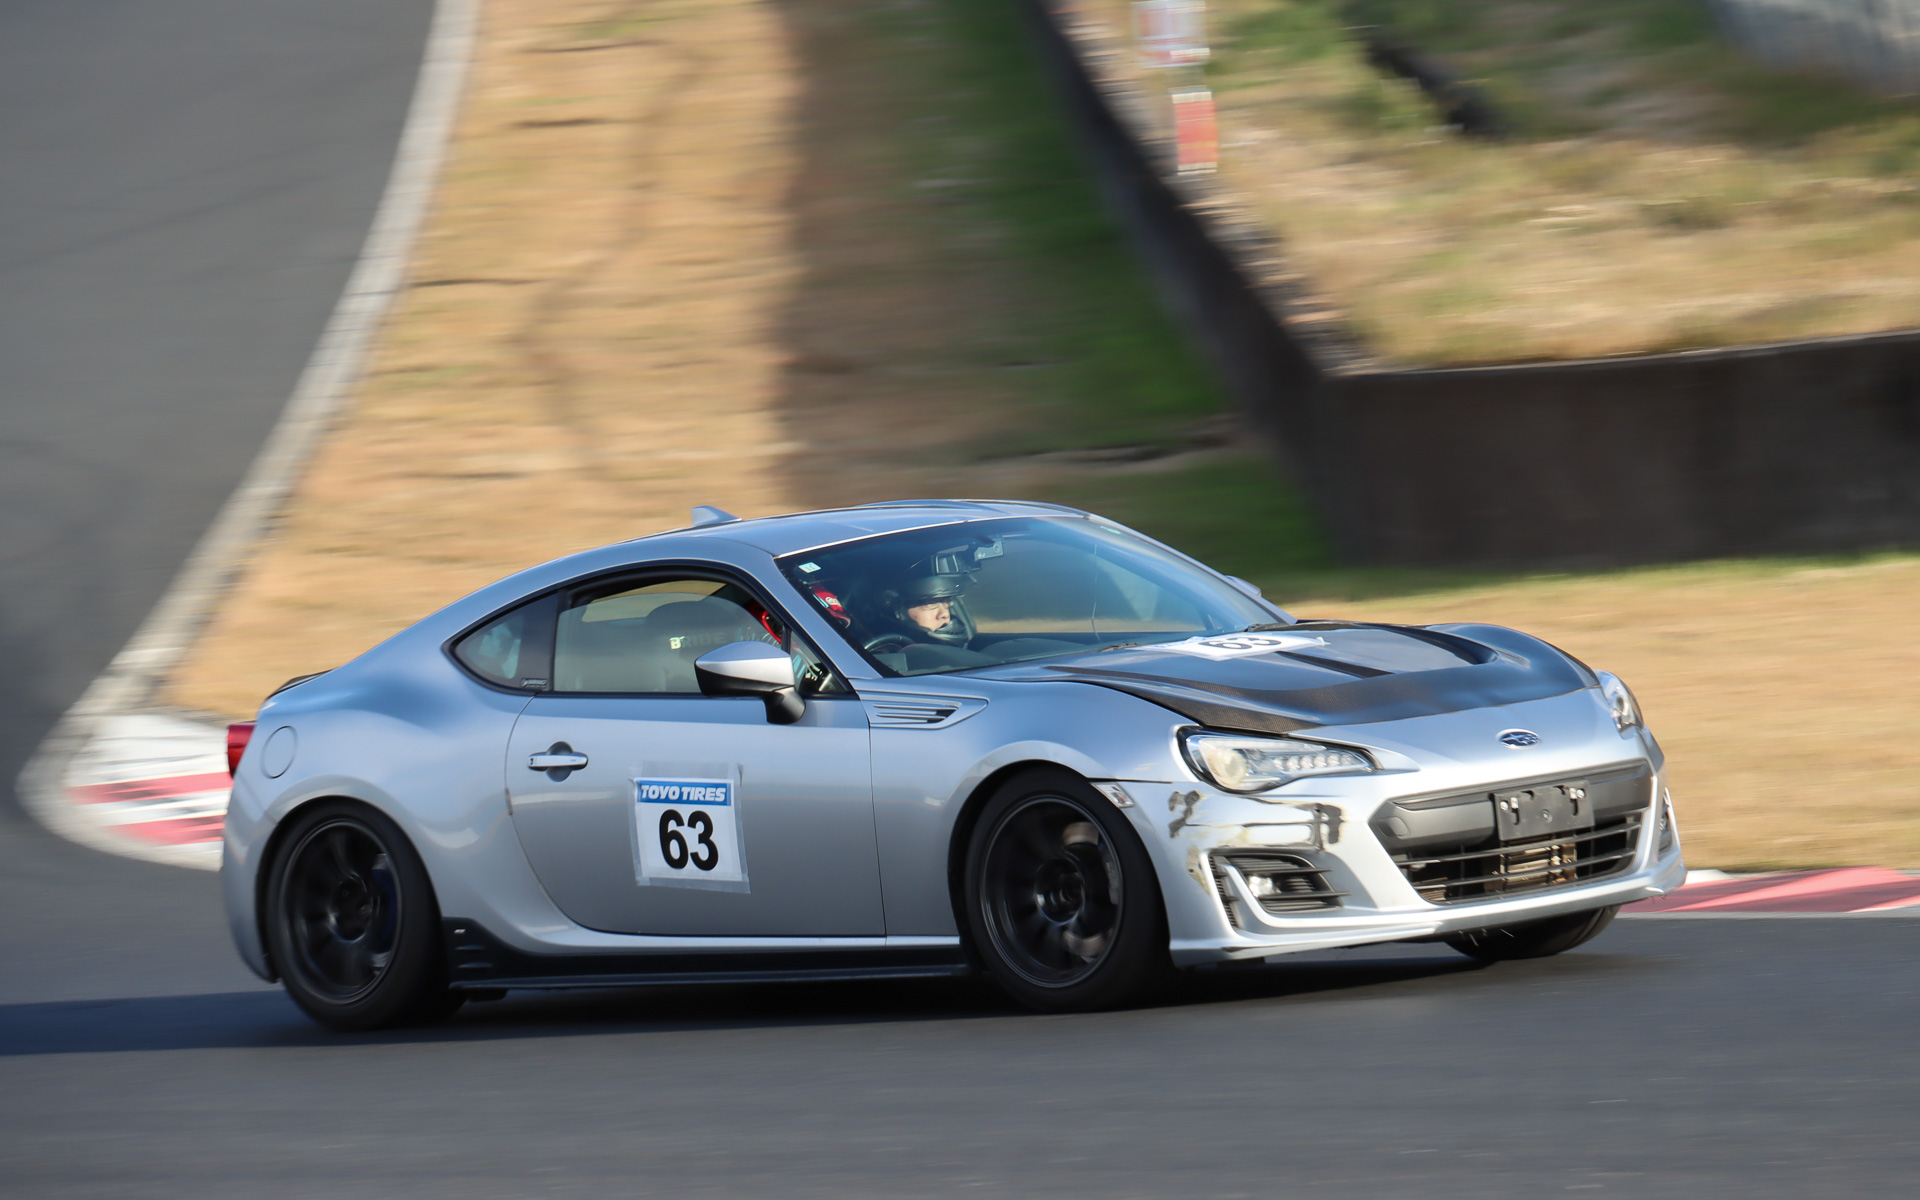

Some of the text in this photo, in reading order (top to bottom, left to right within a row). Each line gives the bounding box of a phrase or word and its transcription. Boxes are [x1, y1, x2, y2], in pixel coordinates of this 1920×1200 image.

[1198, 637, 1282, 649] 63
[641, 784, 727, 802] TOYO TIRES
[659, 809, 719, 871] 63
